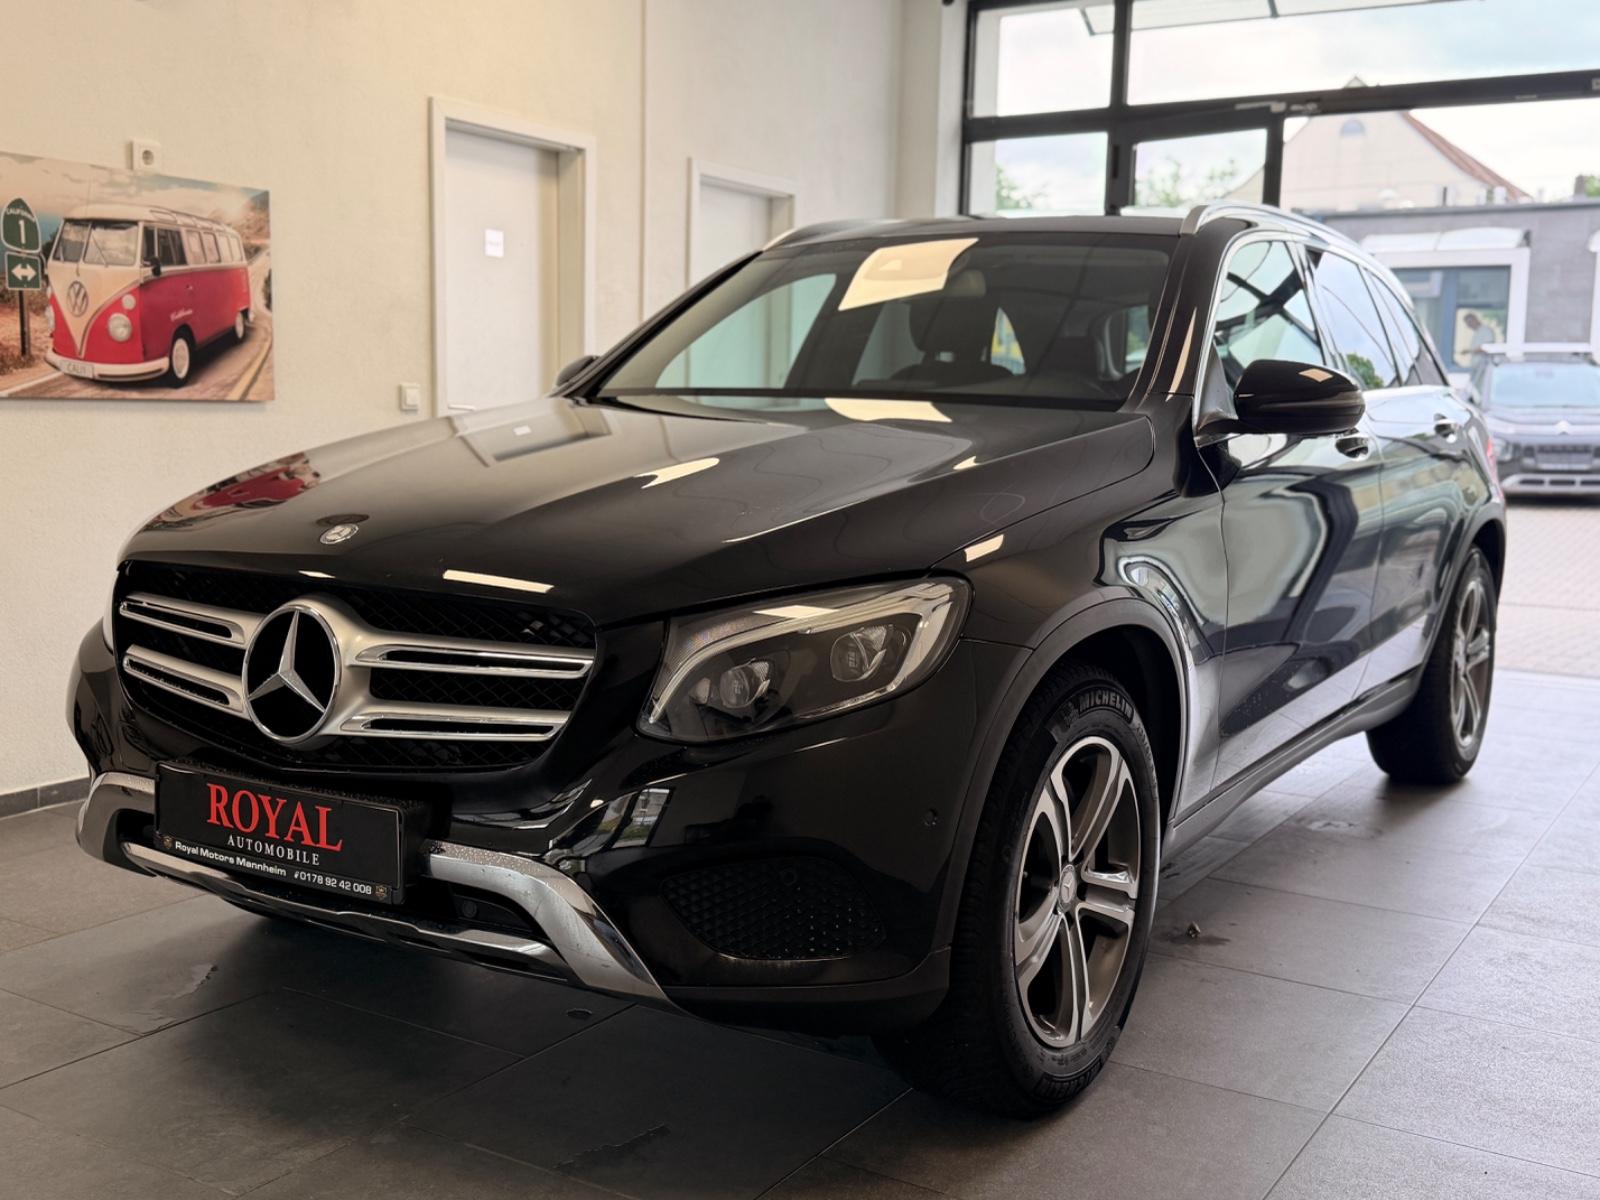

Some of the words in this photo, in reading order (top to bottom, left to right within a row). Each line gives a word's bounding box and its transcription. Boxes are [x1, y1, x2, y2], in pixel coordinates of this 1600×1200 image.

[18, 219, 26, 244] 1
[1079, 689, 1133, 719] MICHELIN
[206, 783, 343, 852] ROYAL
[227, 834, 320, 866] AUTOMOBILE
[175, 841, 199, 856] Royal
[200, 847, 235, 865] Motors
[236, 857, 287, 877] Mannheim
[325, 876, 337, 888] 92
[338, 880, 352, 891] 42
[353, 883, 372, 895] 008
